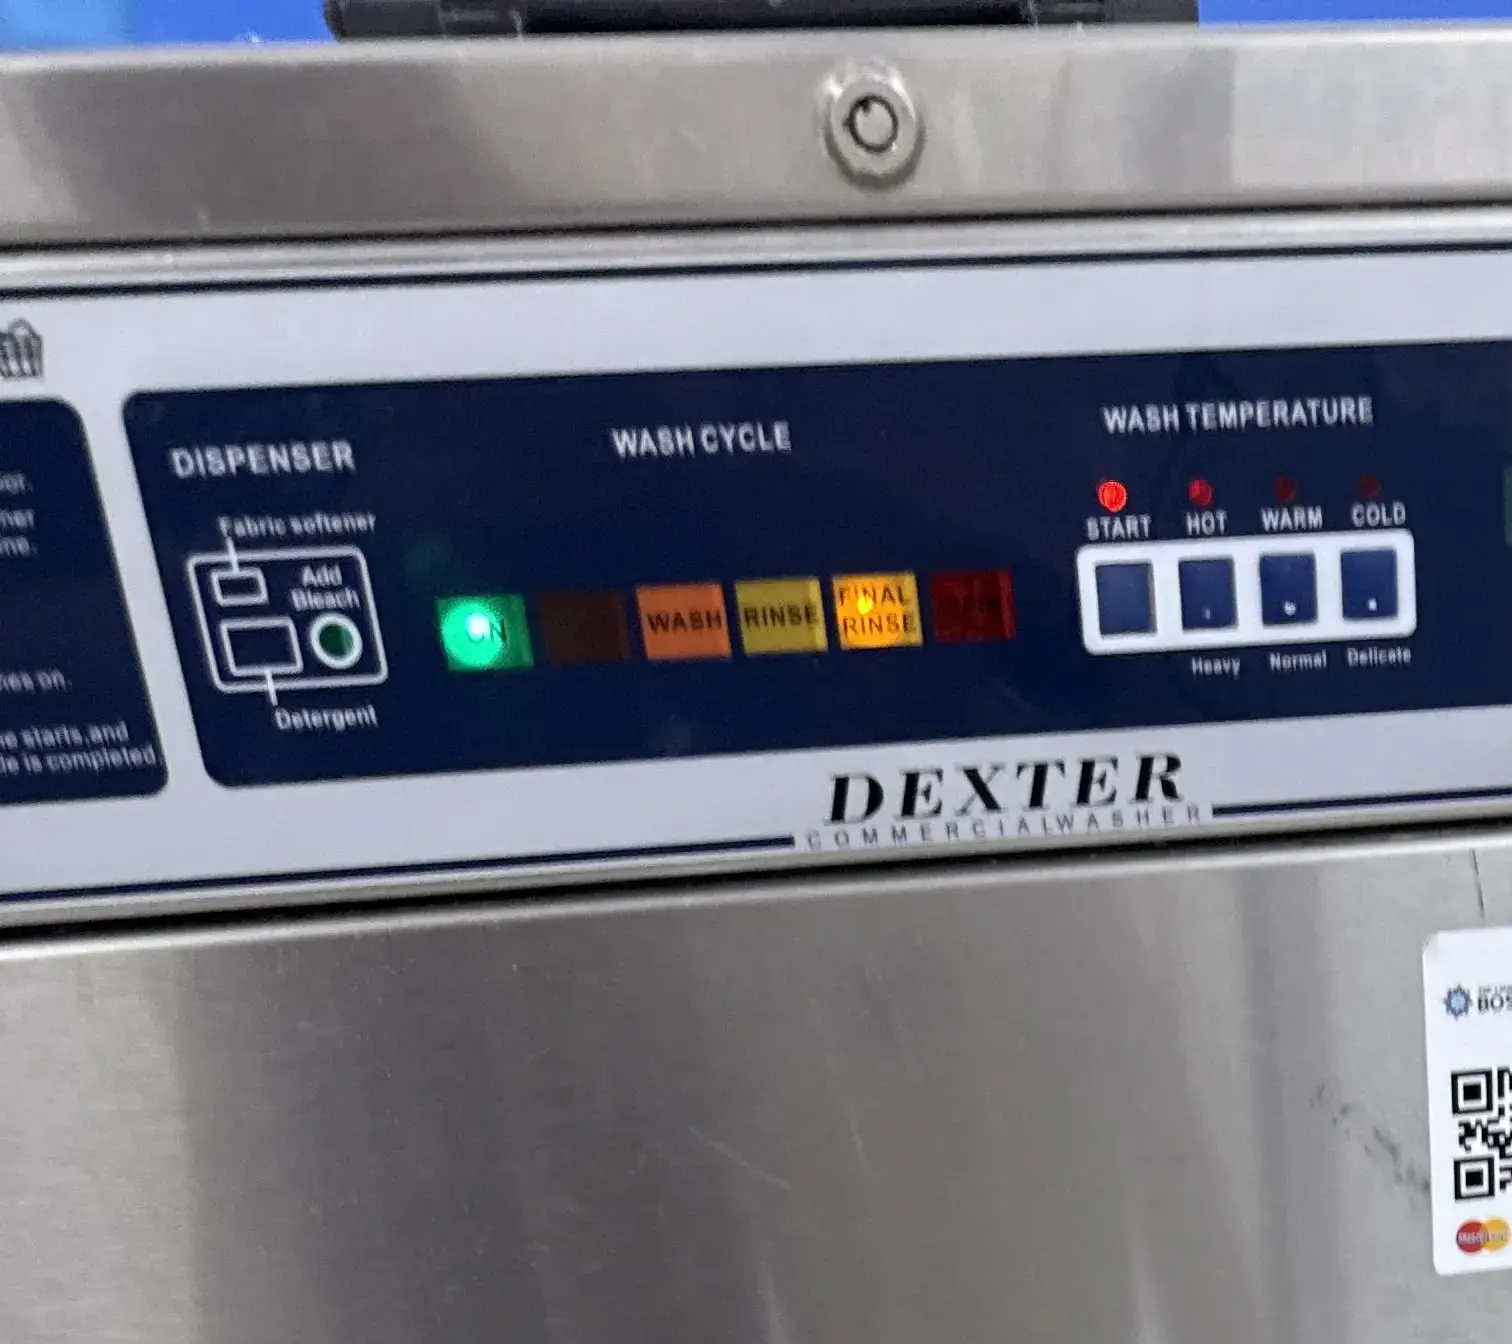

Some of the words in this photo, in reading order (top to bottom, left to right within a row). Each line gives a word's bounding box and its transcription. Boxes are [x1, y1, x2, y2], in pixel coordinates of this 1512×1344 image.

[1103, 404, 1179, 434] WASH
[1185, 396, 1374, 432] TEMPERATURE
[610, 425, 695, 458] WASH
[701, 421, 792, 455] CYCLE
[171, 441, 355, 478] DISPENSER
[217, 516, 286, 538] Fabric
[291, 512, 376, 535] softener
[1186, 510, 1227, 536] HOT
[1261, 506, 1323, 530] WARM
[1352, 501, 1406, 527] COLD
[1087, 514, 1152, 540] START
[302, 564, 342, 587] Add
[291, 587, 360, 611] Bleach
[838, 585, 910, 607] FINAL
[647, 609, 723, 633] WASH
[744, 602, 819, 631] RINSE
[842, 611, 917, 636] RINSE
[1191, 656, 1241, 680] Heavy
[1269, 650, 1327, 672] Normal
[1348, 646, 1412, 668] Delicate
[275, 705, 378, 730] Detergent
[824, 752, 1183, 826] DEXTER
